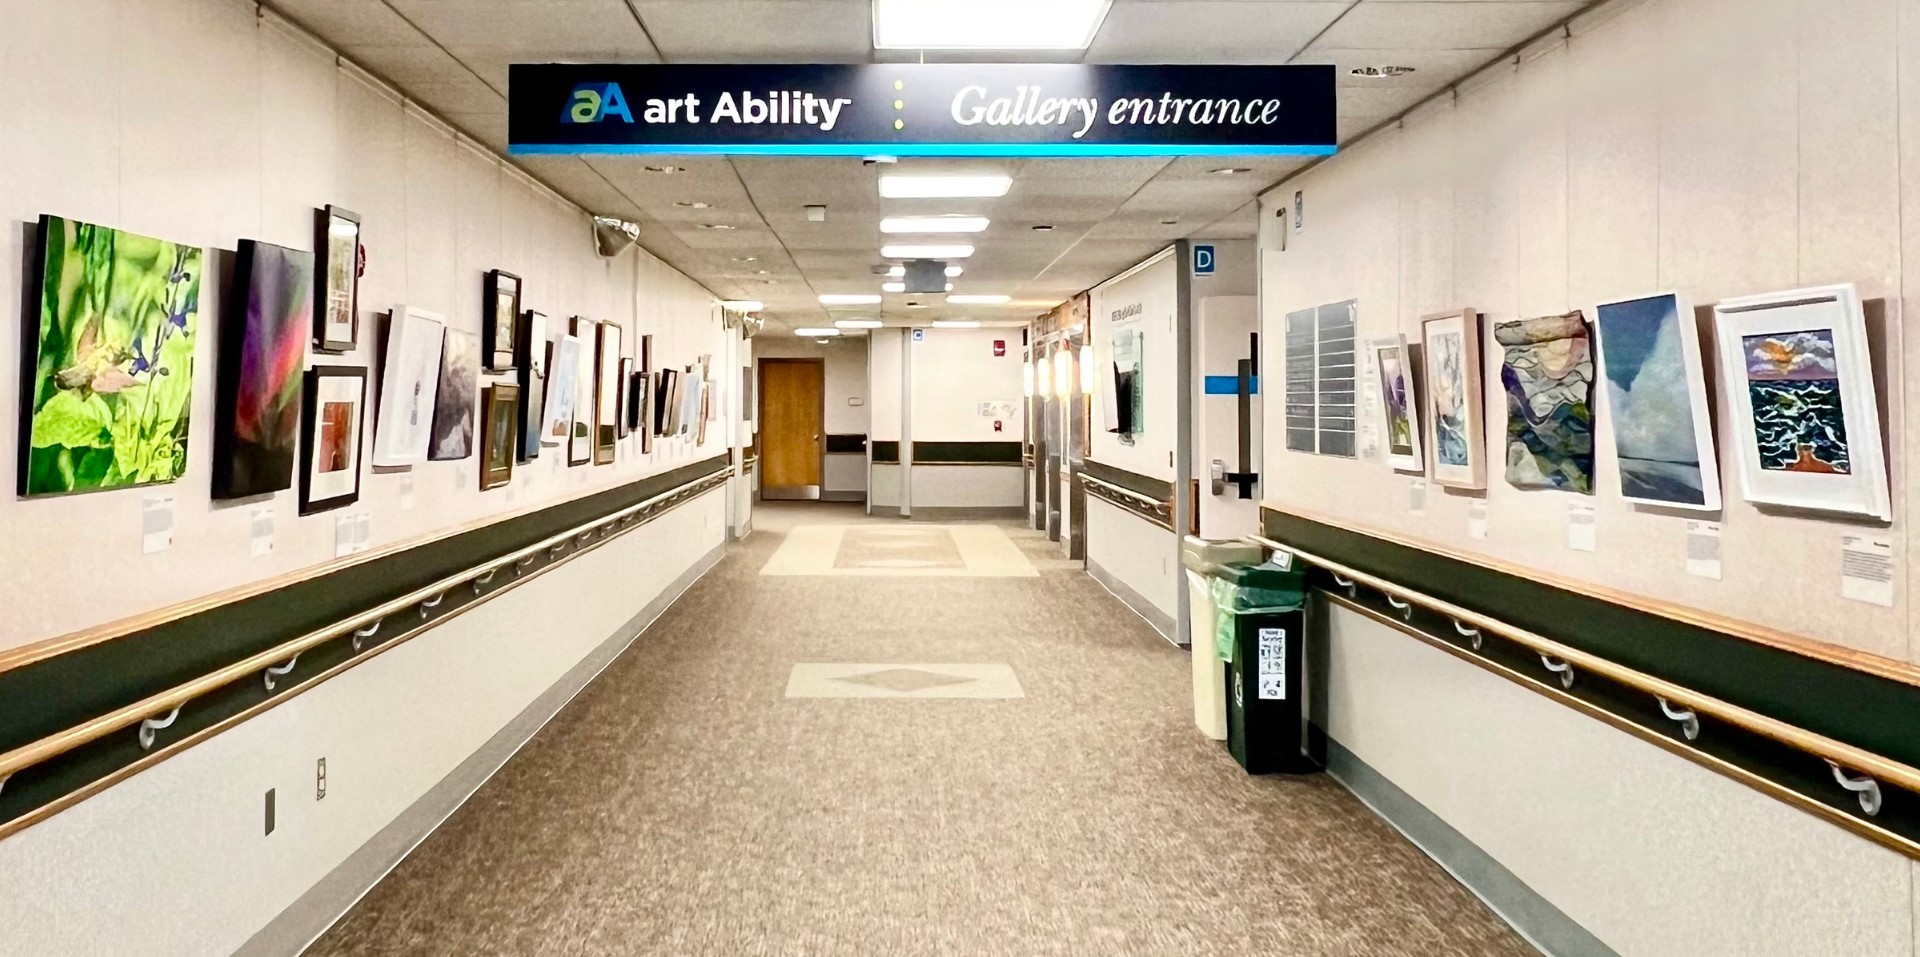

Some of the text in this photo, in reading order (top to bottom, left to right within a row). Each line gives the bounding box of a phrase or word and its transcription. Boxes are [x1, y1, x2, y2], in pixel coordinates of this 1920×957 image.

[643, 93, 701, 124] art
[950, 84, 1281, 139] Gallery entrance
[1197, 250, 1212, 268] D
